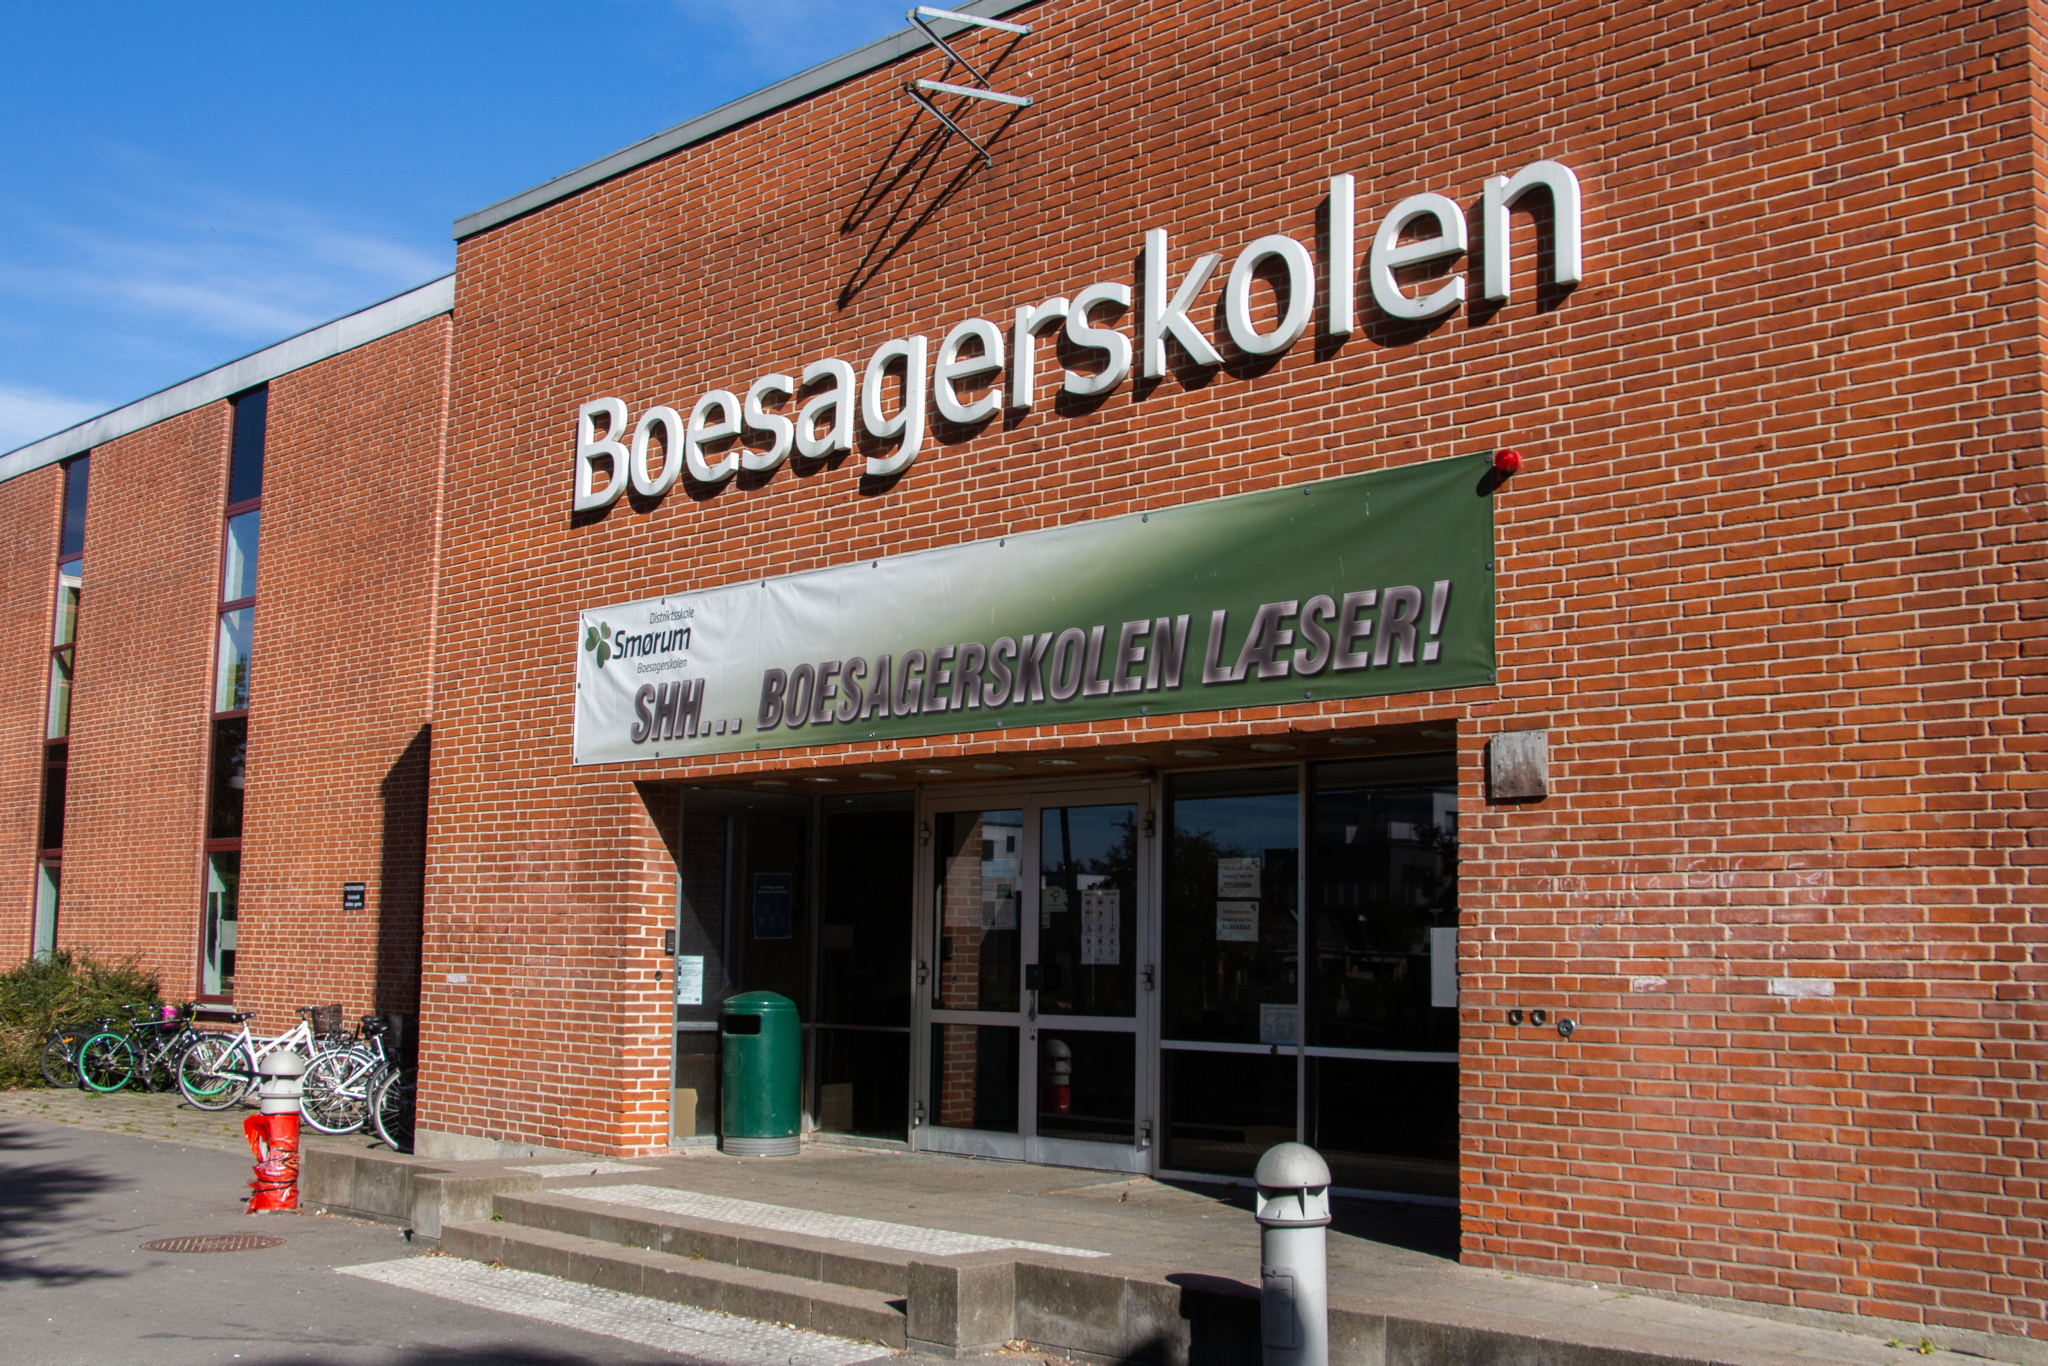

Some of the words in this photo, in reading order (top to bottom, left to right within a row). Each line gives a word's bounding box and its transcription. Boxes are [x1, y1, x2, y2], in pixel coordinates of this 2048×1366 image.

[572, 160, 1583, 512] Boesagerskolen
[650, 606, 695, 625] Distriktsskole
[612, 626, 692, 660] Smørum
[630, 678, 742, 744] SHH...
[756, 615, 1190, 731] BOESAGERSKOLEN
[1202, 580, 1451, 685] LÆSER!
[637, 657, 688, 674] Boesagerskolen
